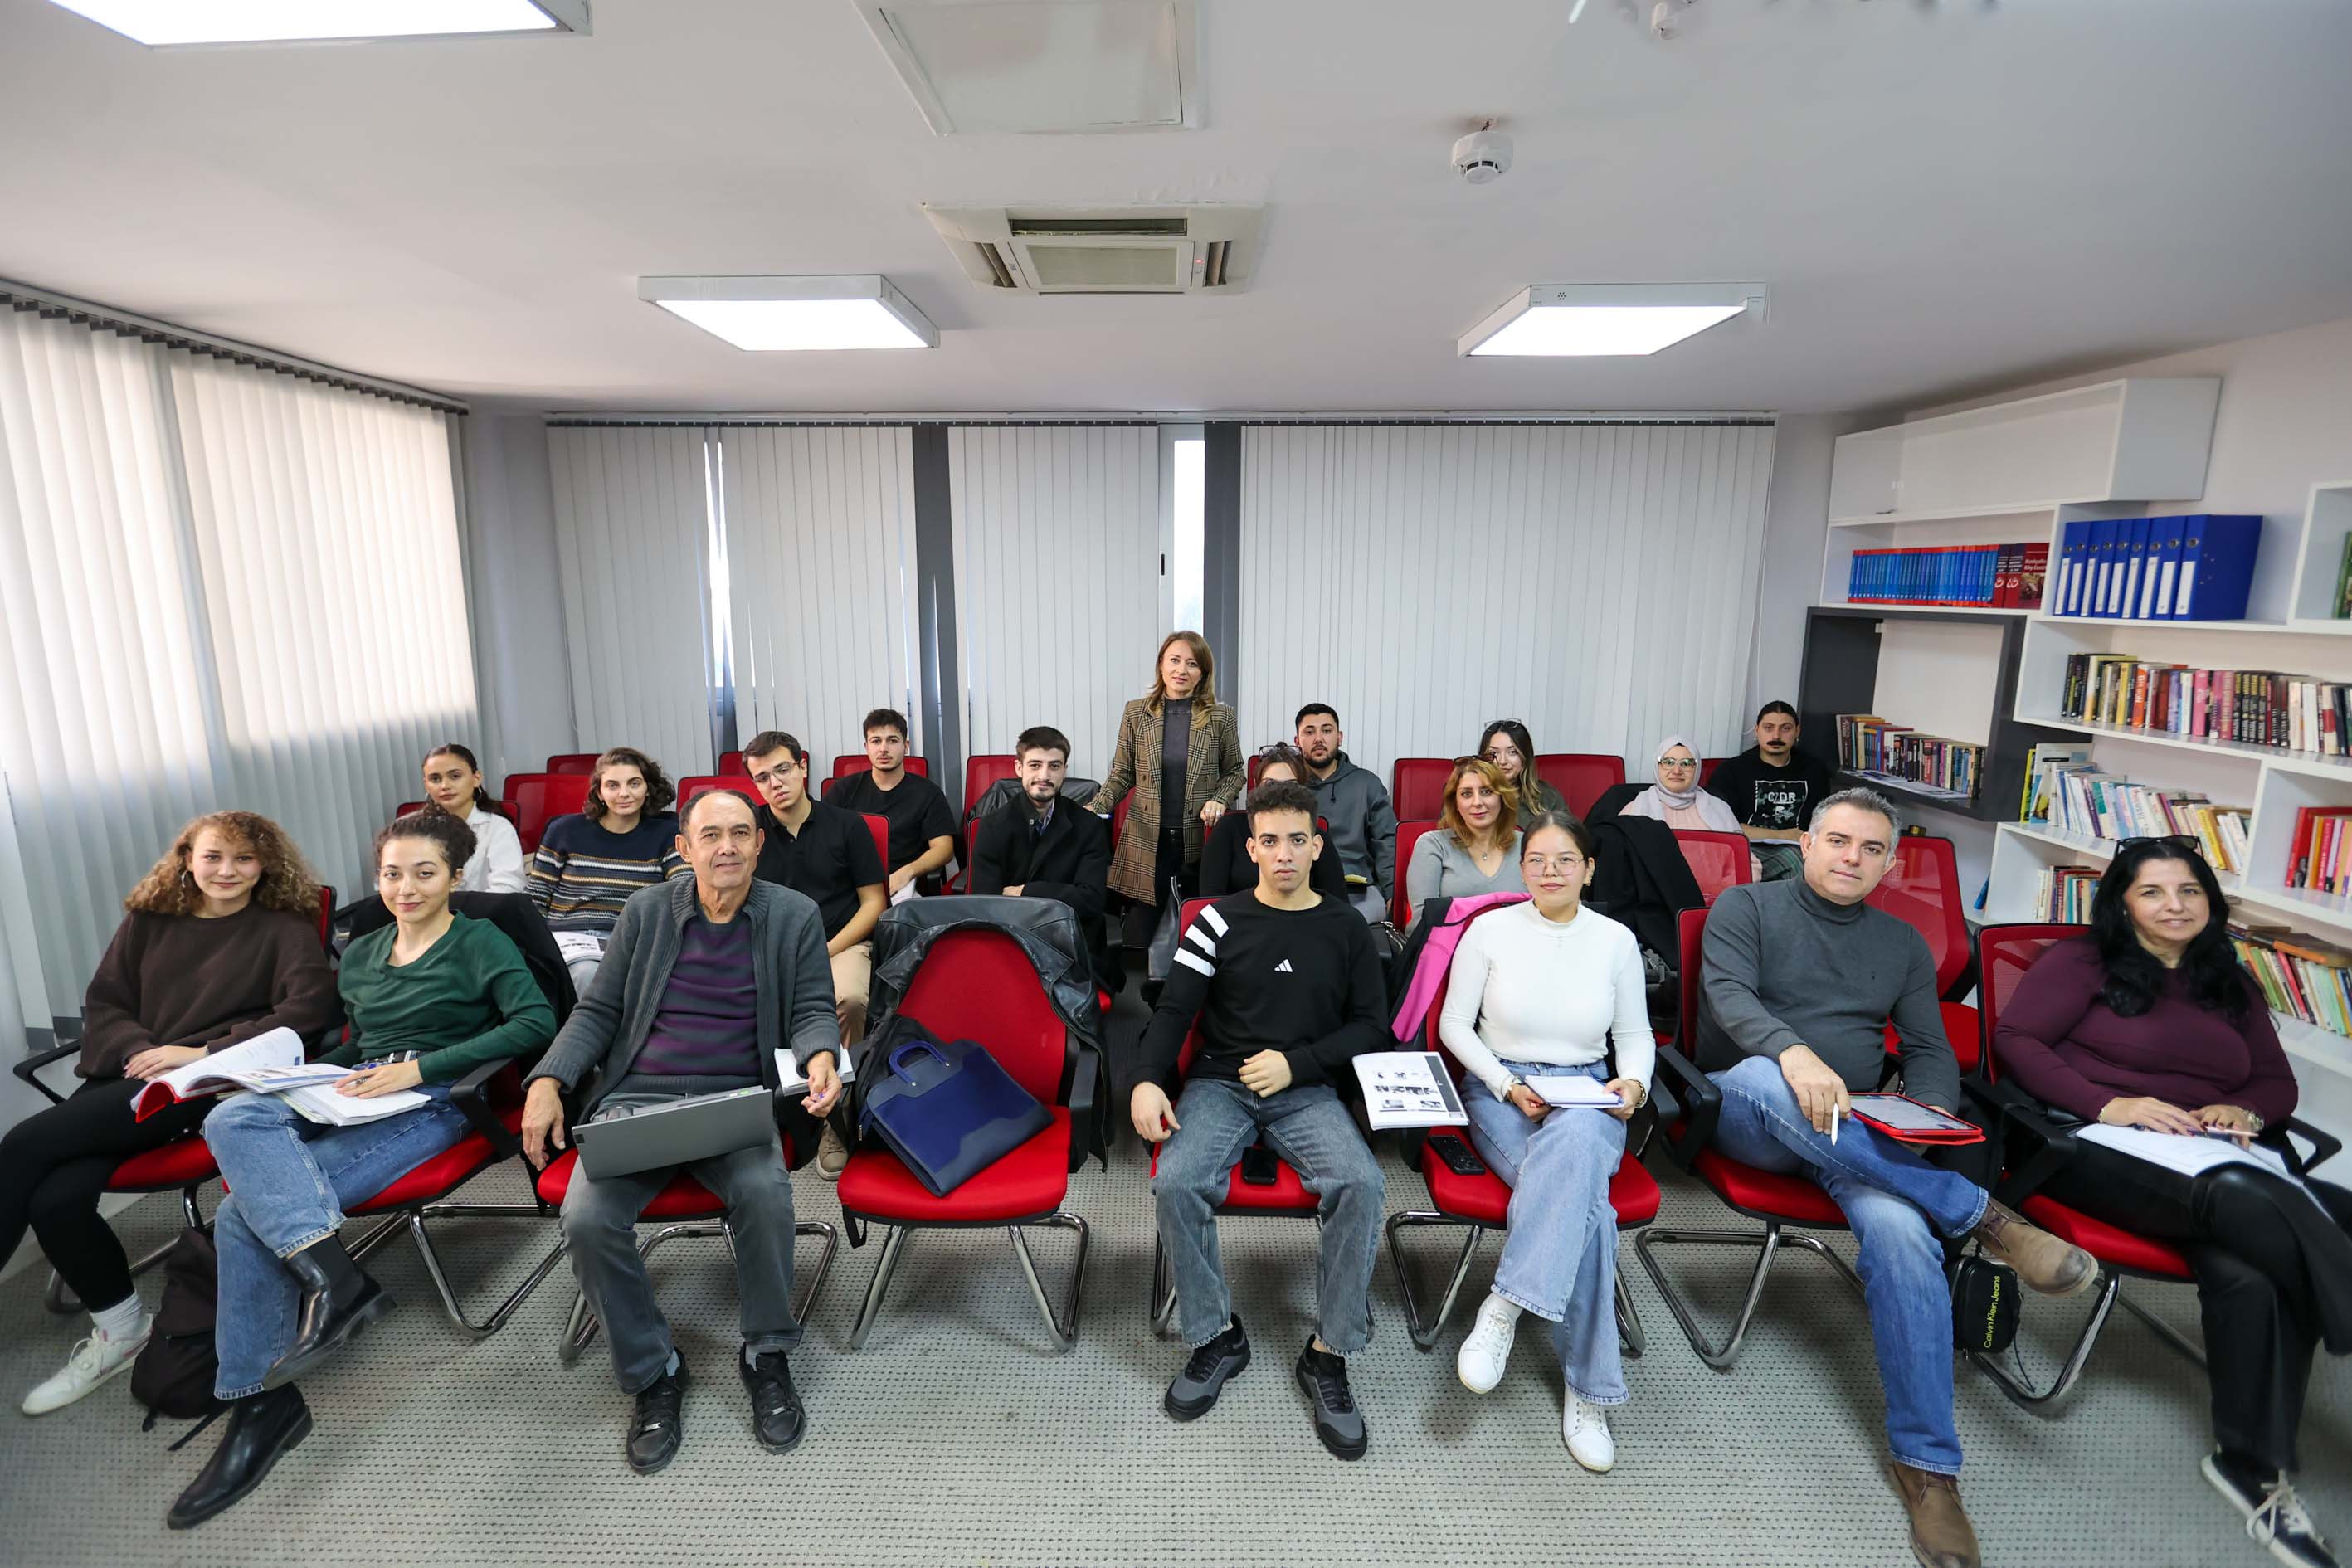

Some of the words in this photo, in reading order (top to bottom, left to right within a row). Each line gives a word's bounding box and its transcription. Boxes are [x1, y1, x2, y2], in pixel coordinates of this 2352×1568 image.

[1991, 1275, 2000, 1301] Jeans
[1987, 1302, 1998, 1322] Klein
[1984, 1322, 1994, 1348] Calvin
